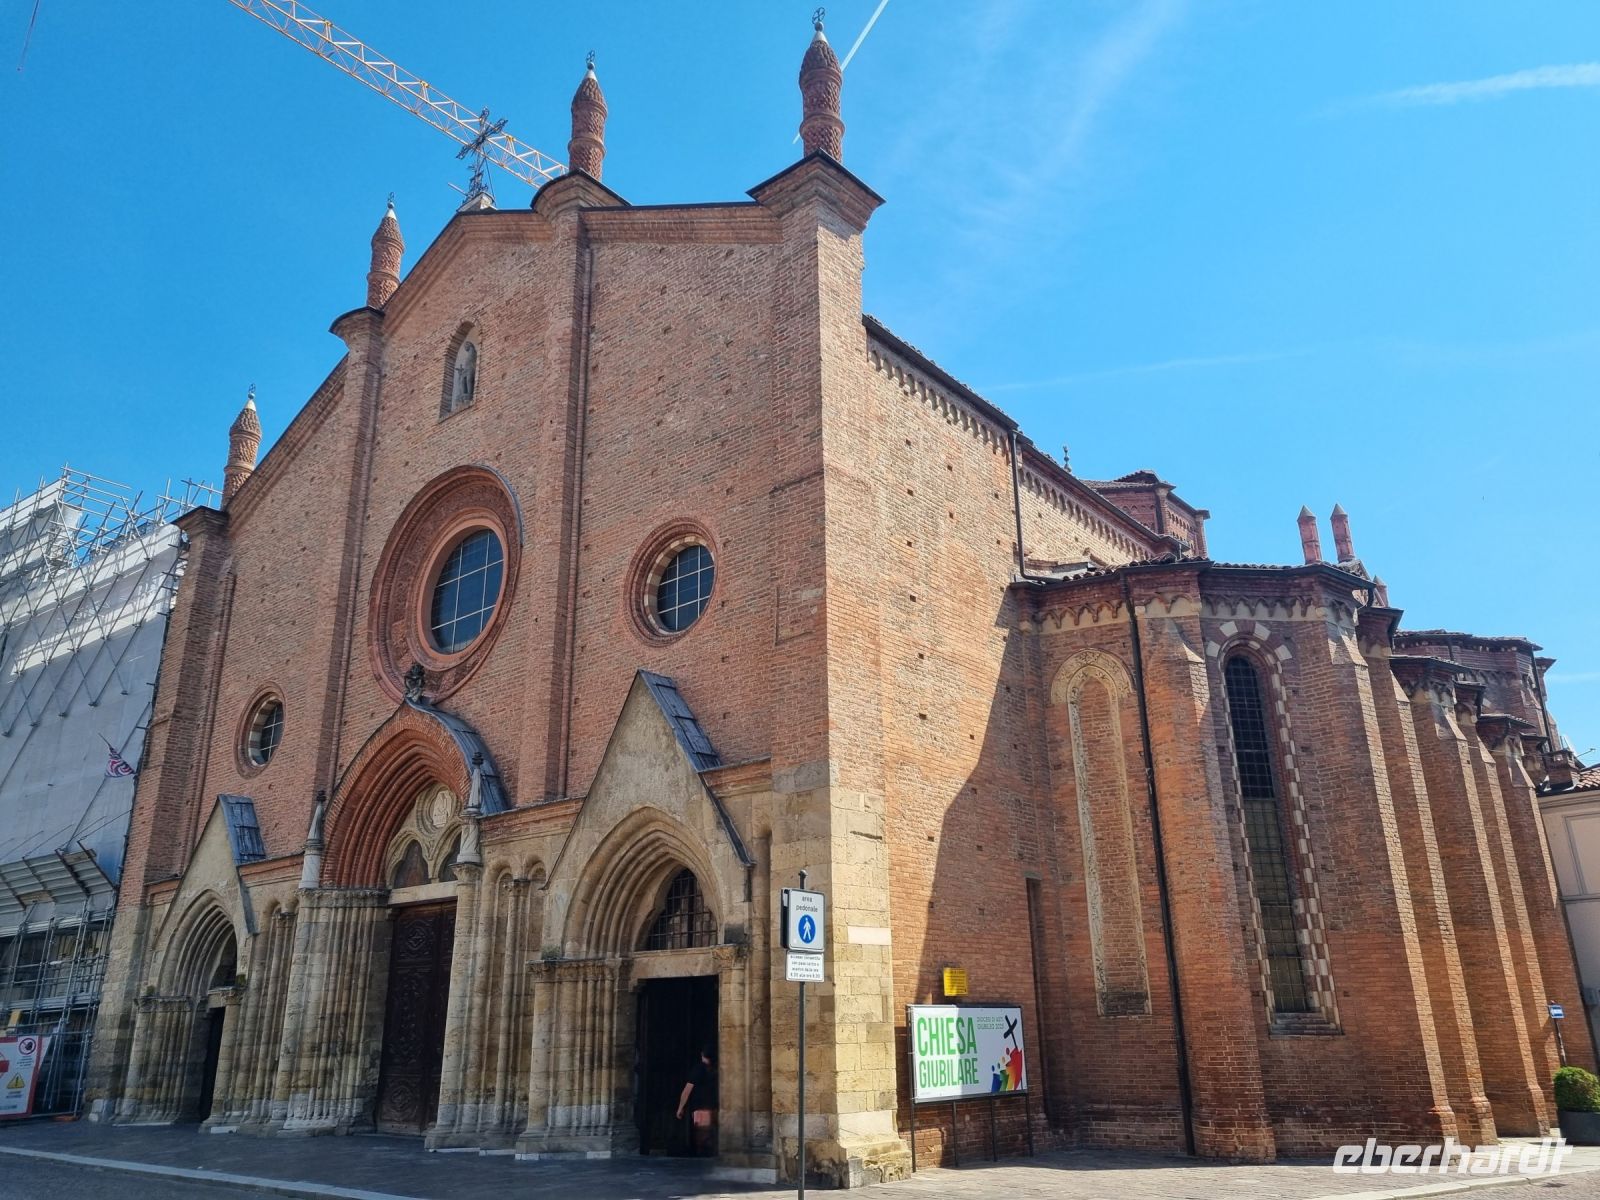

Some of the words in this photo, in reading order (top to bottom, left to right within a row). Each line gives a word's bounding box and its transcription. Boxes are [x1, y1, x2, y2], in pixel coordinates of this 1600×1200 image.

[796, 904, 818, 912] pedonale
[917, 1017, 977, 1056] CHIESA
[919, 1058, 979, 1089] GIUBILARE
